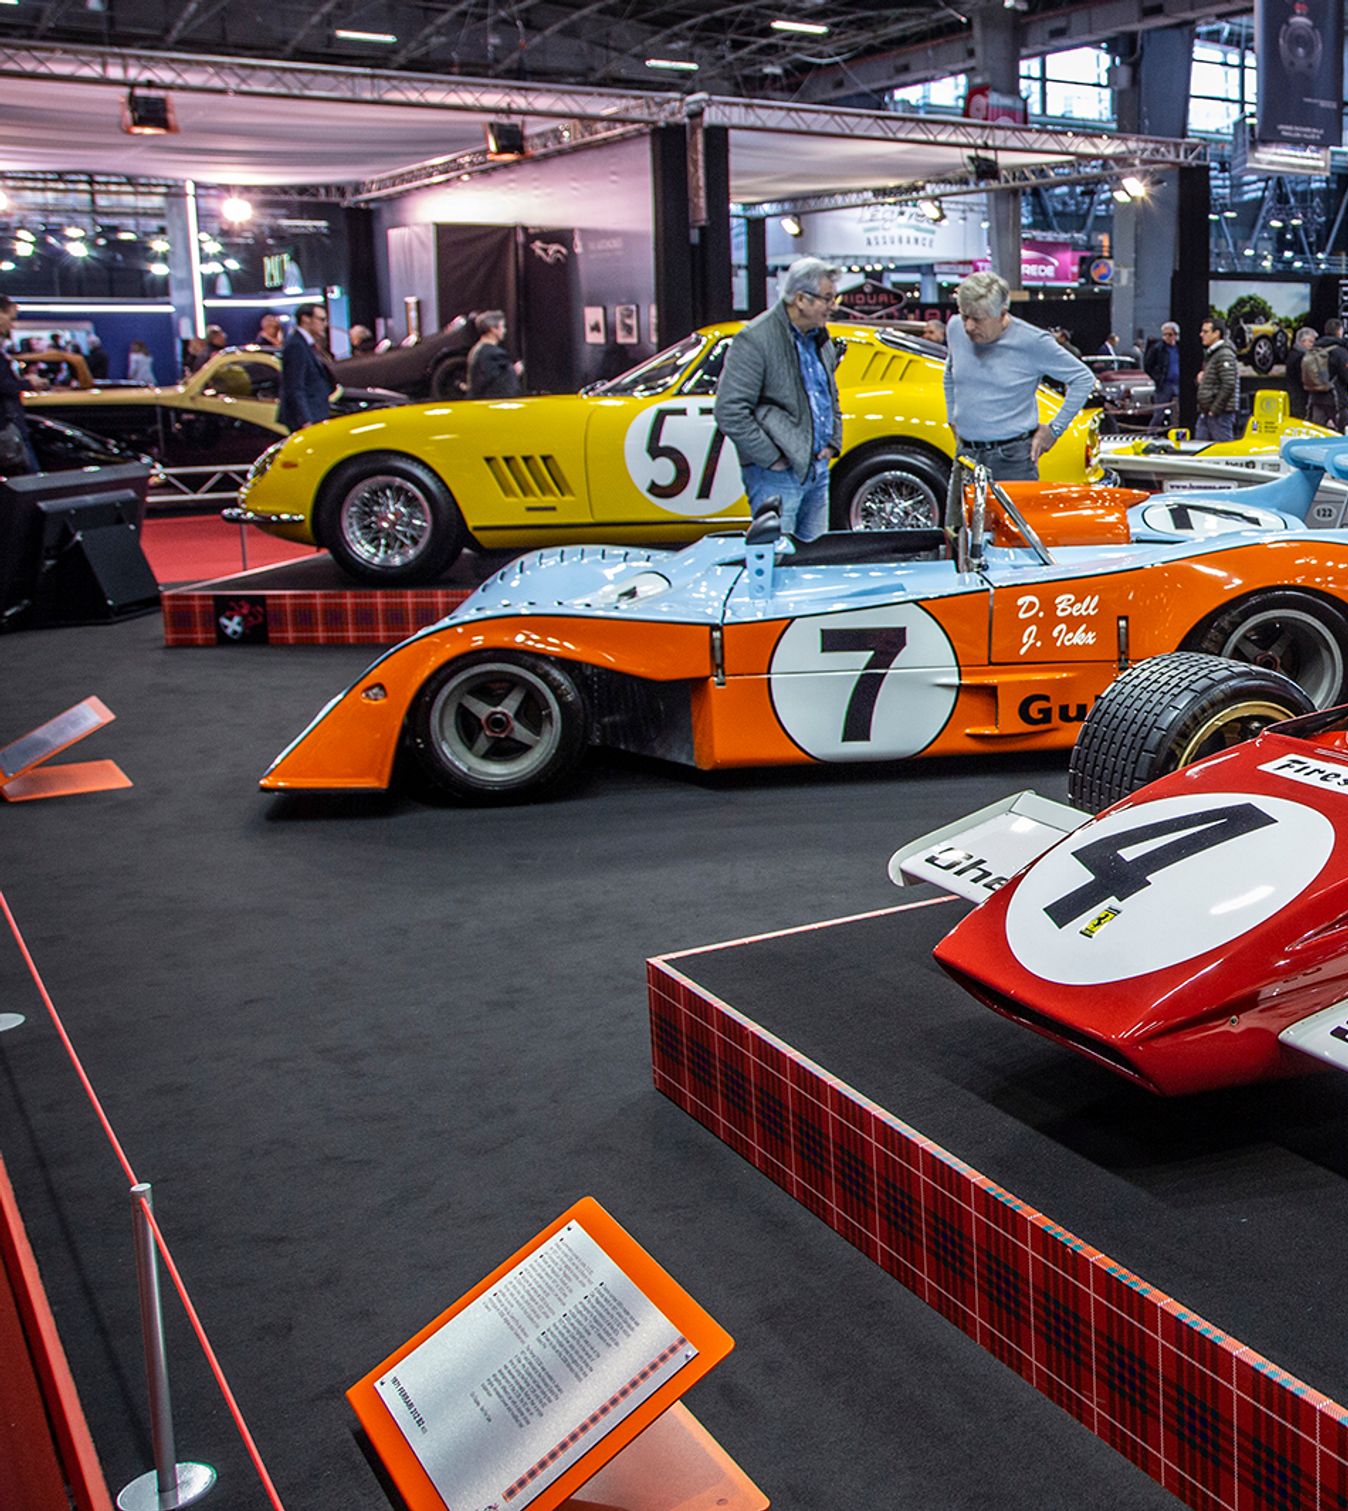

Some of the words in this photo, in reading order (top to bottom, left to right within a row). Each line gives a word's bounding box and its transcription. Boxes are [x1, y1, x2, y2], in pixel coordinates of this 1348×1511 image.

[645, 407, 727, 500] 57
[1316, 508, 1333, 518] 122
[1017, 595, 1044, 619] D.
[1054, 594, 1100, 617] Bell
[1019, 625, 1042, 655] J.
[1052, 623, 1097, 647] Ickx
[820, 627, 907, 742] 7
[1018, 693, 1105, 726] Gu
[924, 847, 1009, 891] She
[1042, 802, 1280, 930] 4
